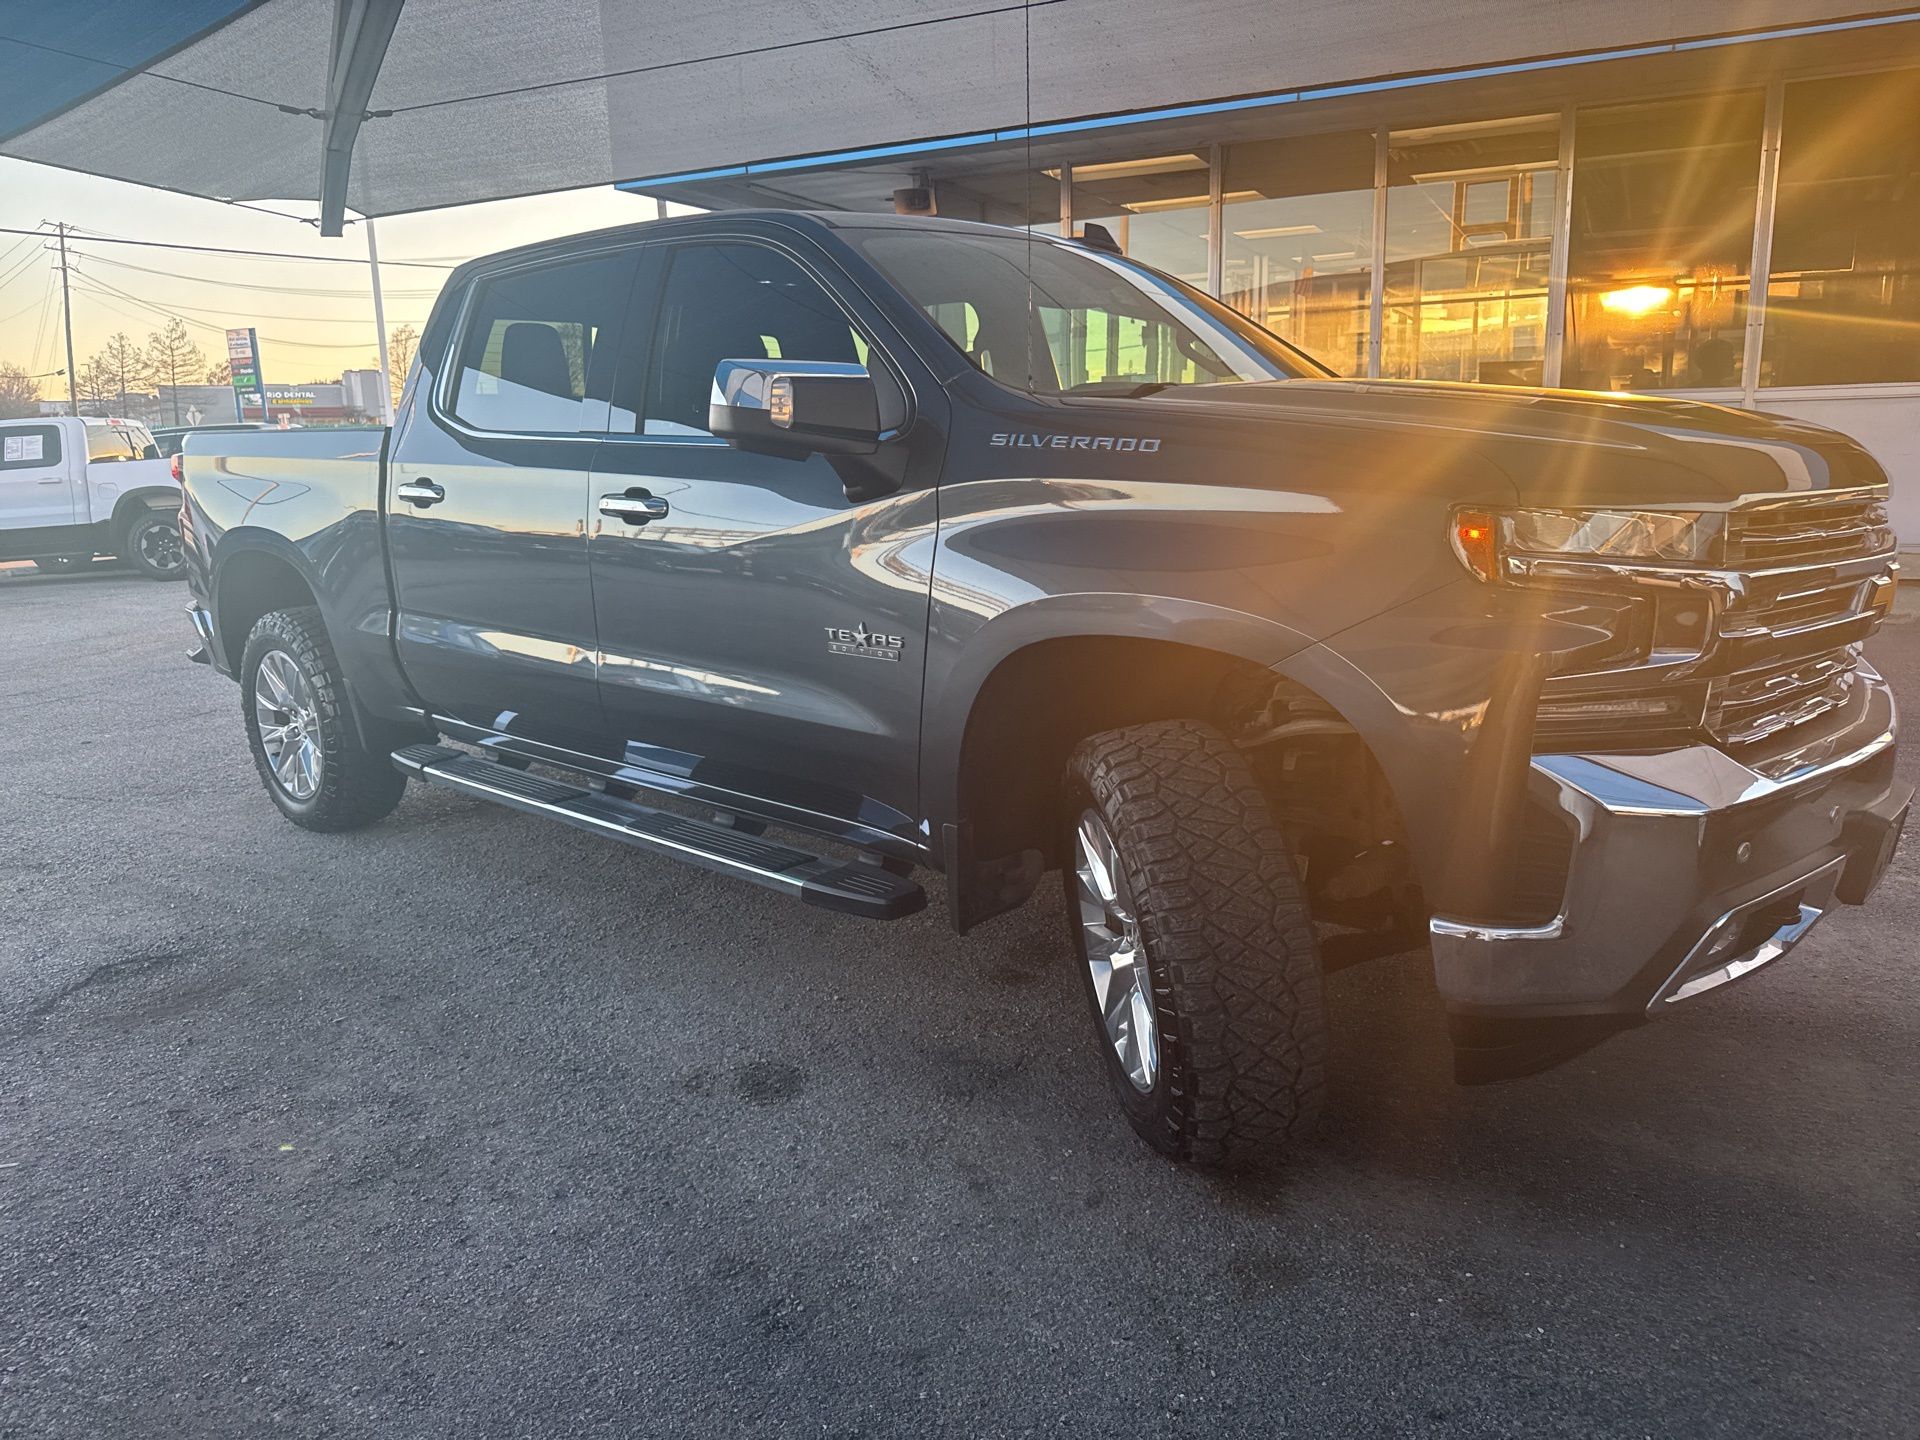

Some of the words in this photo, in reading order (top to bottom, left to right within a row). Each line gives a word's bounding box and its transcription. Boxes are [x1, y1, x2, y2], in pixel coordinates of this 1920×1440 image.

[989, 433, 1161, 452] SILVERADO
[824, 621, 902, 648] TEXAS
[831, 644, 895, 659] EDITION
